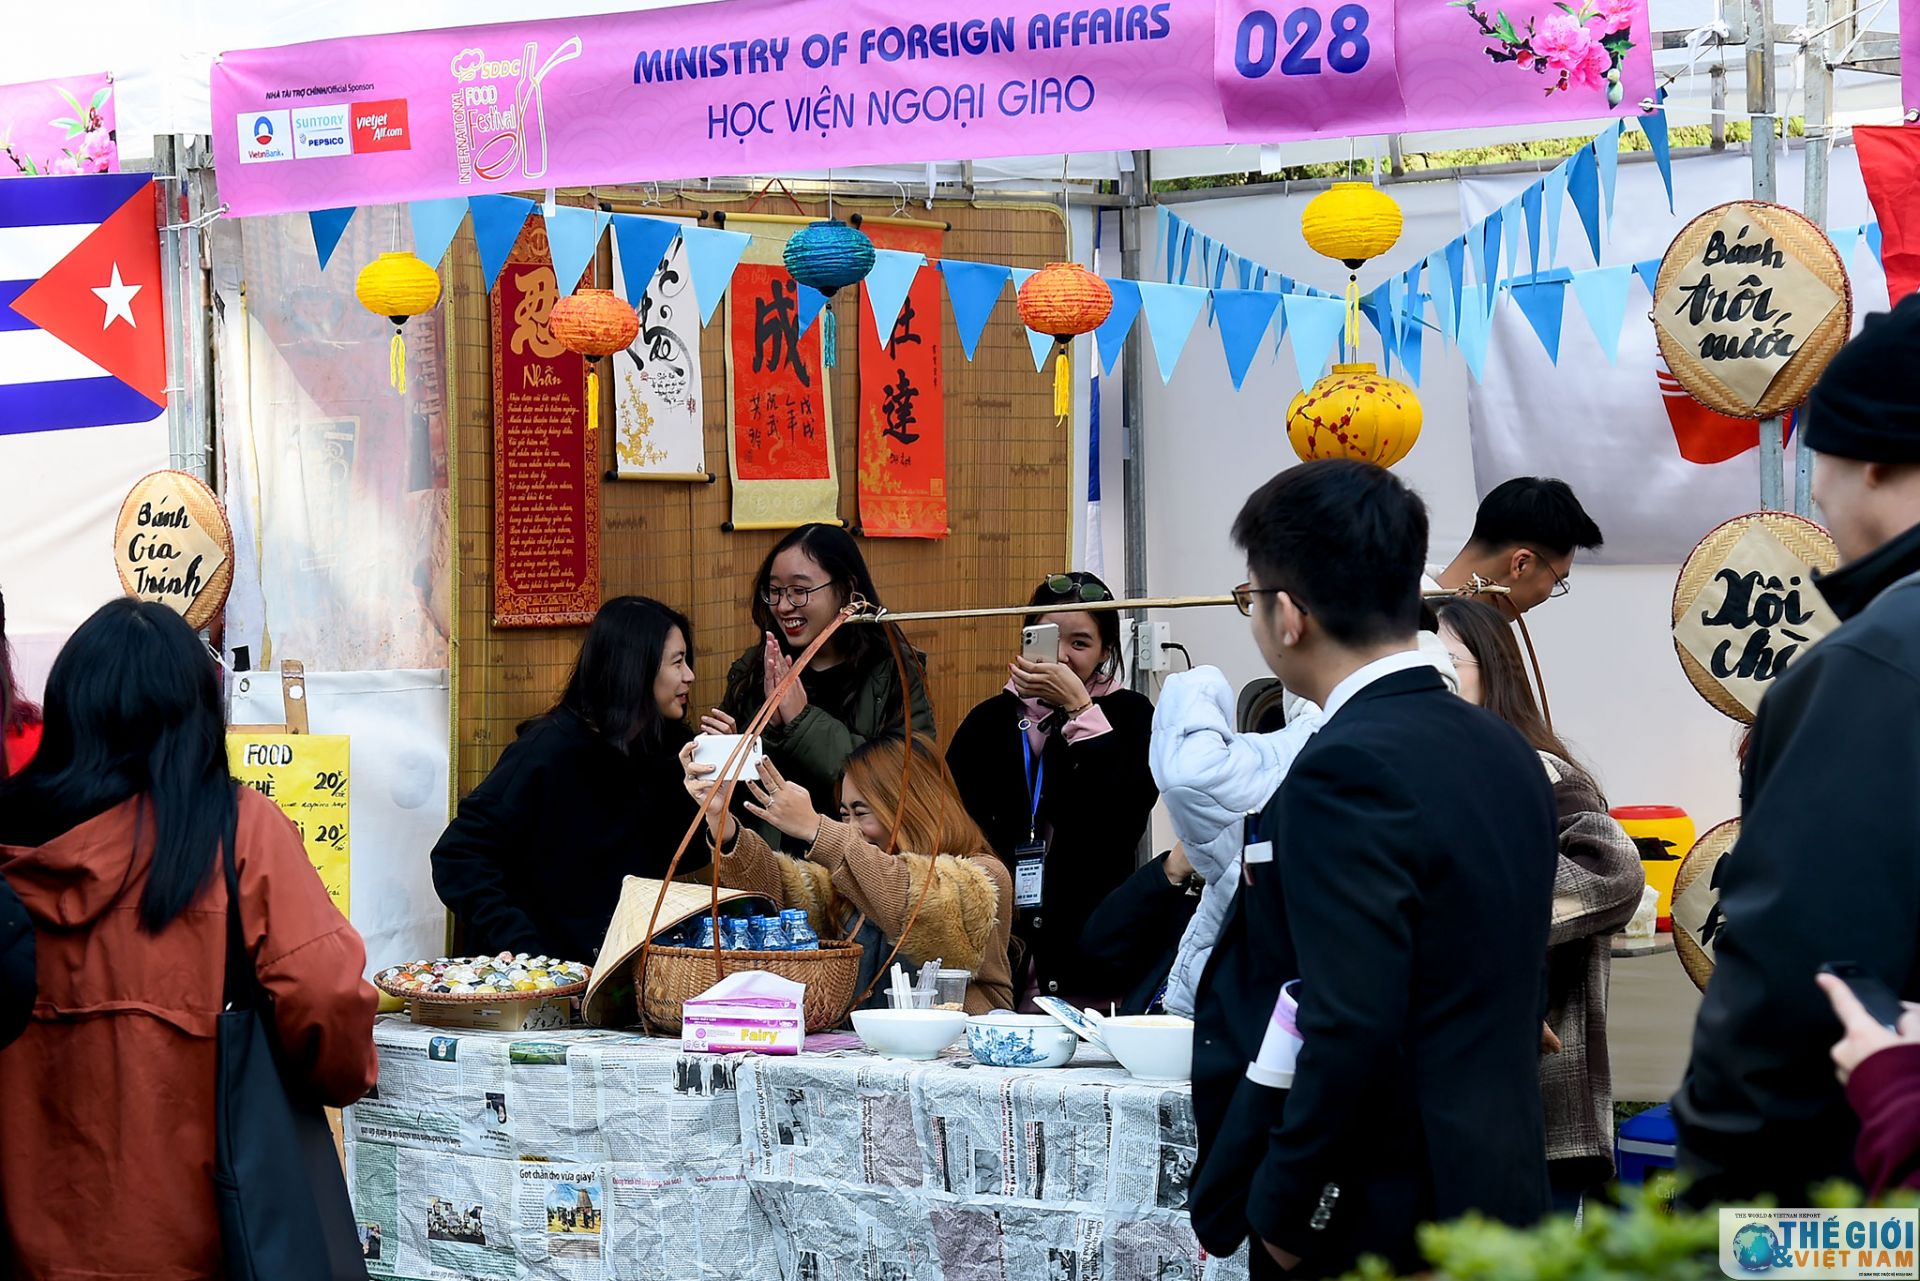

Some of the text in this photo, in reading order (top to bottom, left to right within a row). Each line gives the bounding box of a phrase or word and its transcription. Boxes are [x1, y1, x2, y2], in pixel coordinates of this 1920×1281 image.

[633, 3, 1171, 84] MINISTRY OF FOREIGN AFFAIRS
[1235, 4, 1370, 78] 028
[265, 88, 280, 100] NHÀ
[281, 87, 292, 98] TÀI
[348, 82, 375, 93] Sponsors
[465, 85, 498, 106] FOOD
[708, 74, 1095, 144] HỌC VIỆN NGOẠI GIAO
[308, 137, 344, 147] PEPSICO
[452, 87, 472, 185] INTERNATIONAL
[468, 104, 516, 149] Festival
[1702, 225, 1785, 269] Bánh
[1675, 273, 1780, 326] trôi
[137, 495, 190, 529] Bánh
[134, 554, 203, 602] Trịnh
[1701, 568, 1815, 630] Xôi
[248, 744, 293, 765] FOOD
[741, 1028, 779, 1044] Fairy
